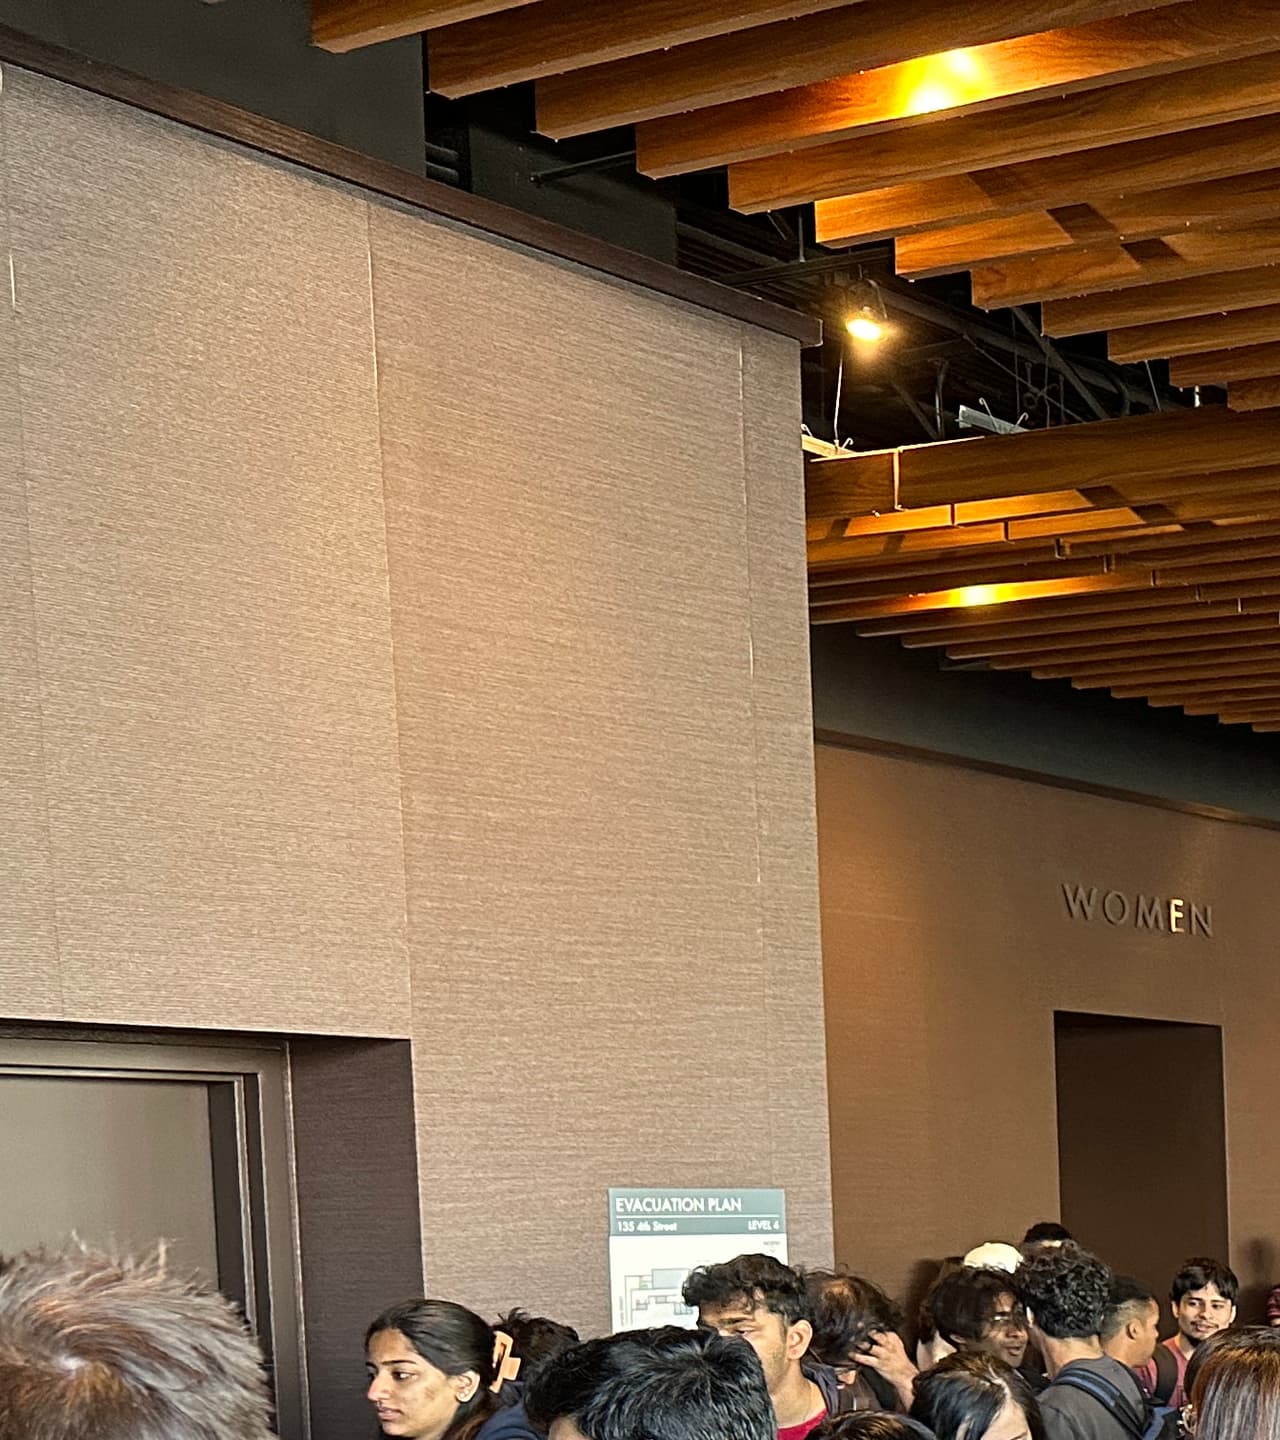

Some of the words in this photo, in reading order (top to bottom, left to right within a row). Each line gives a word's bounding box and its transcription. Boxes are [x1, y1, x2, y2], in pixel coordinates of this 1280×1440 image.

[1061, 884, 1213, 938] WOMEN
[615, 1198, 704, 1212] EVACUATION
[707, 1198, 742, 1212] PLAN
[618, 1221, 635, 1232] 135
[653, 1221, 678, 1232] Street
[747, 1220, 772, 1231] LEVEL
